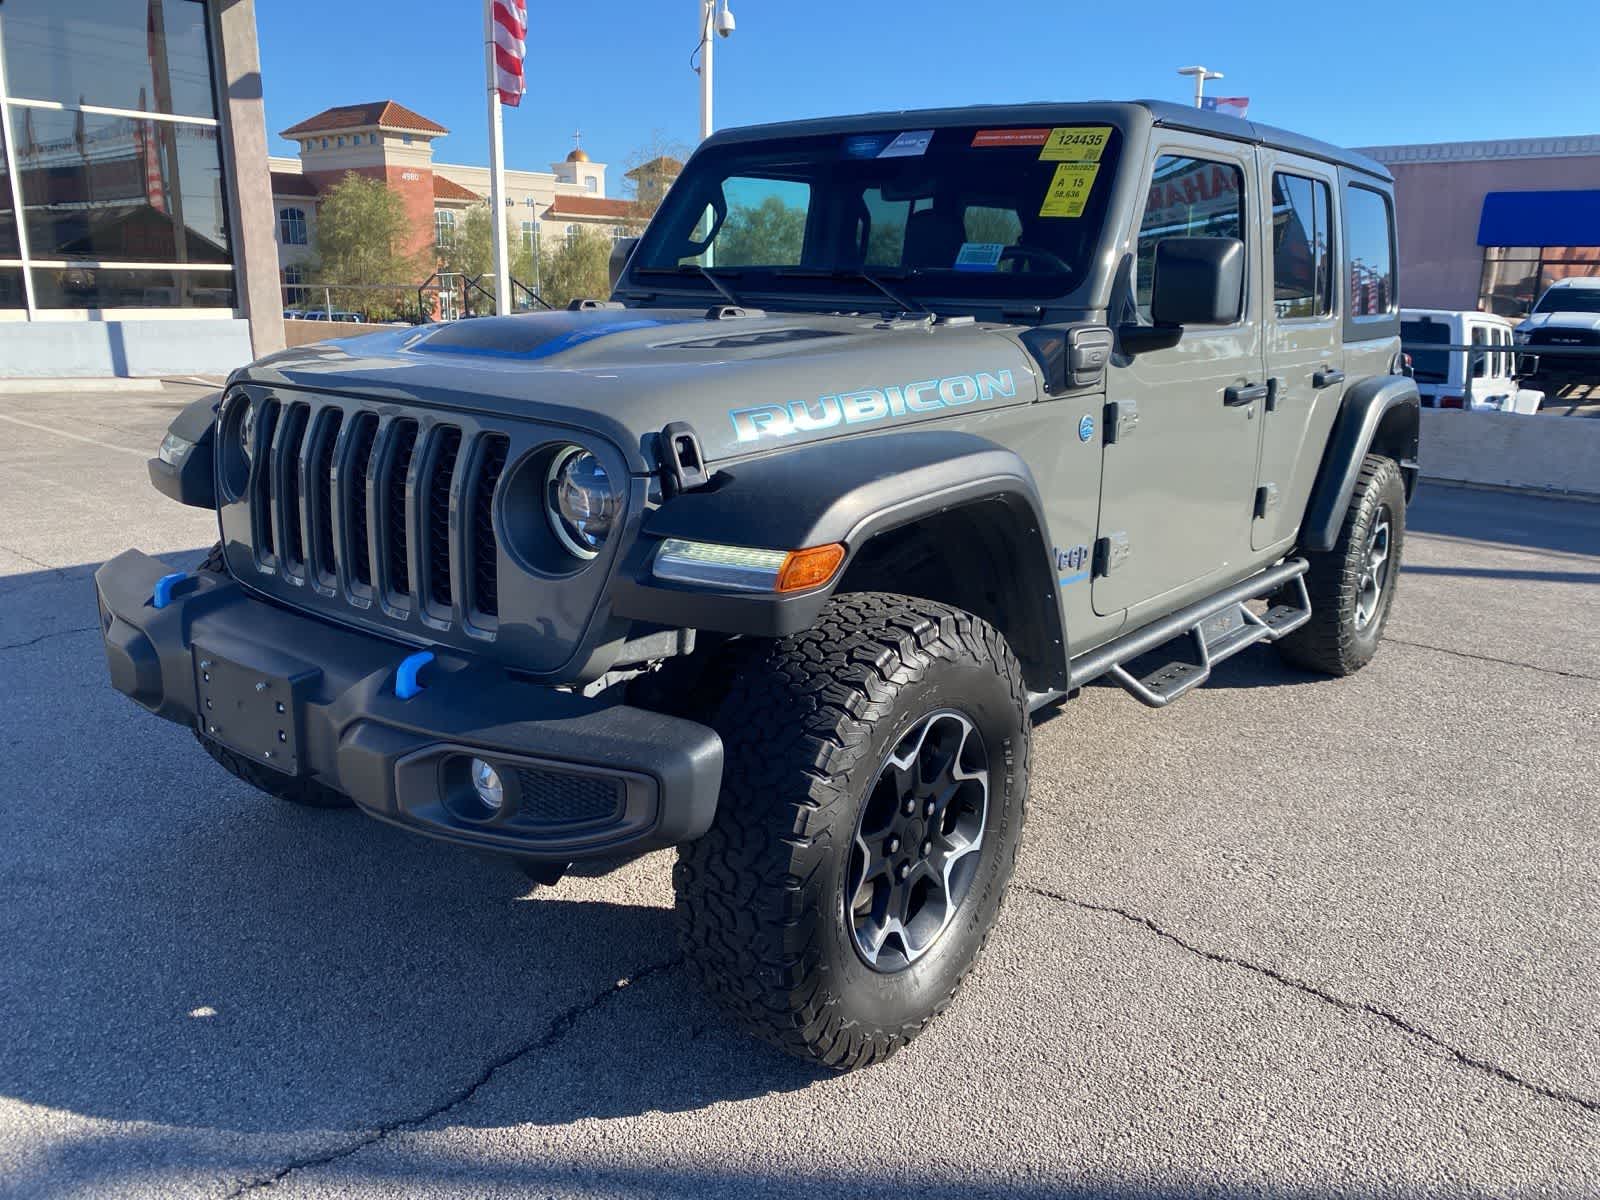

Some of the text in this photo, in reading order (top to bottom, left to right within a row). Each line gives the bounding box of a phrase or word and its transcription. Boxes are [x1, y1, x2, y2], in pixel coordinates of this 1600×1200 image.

[1059, 135, 1103, 145] 124435
[1073, 178, 1084, 187] 15
[729, 369, 1016, 442] RUBICON
